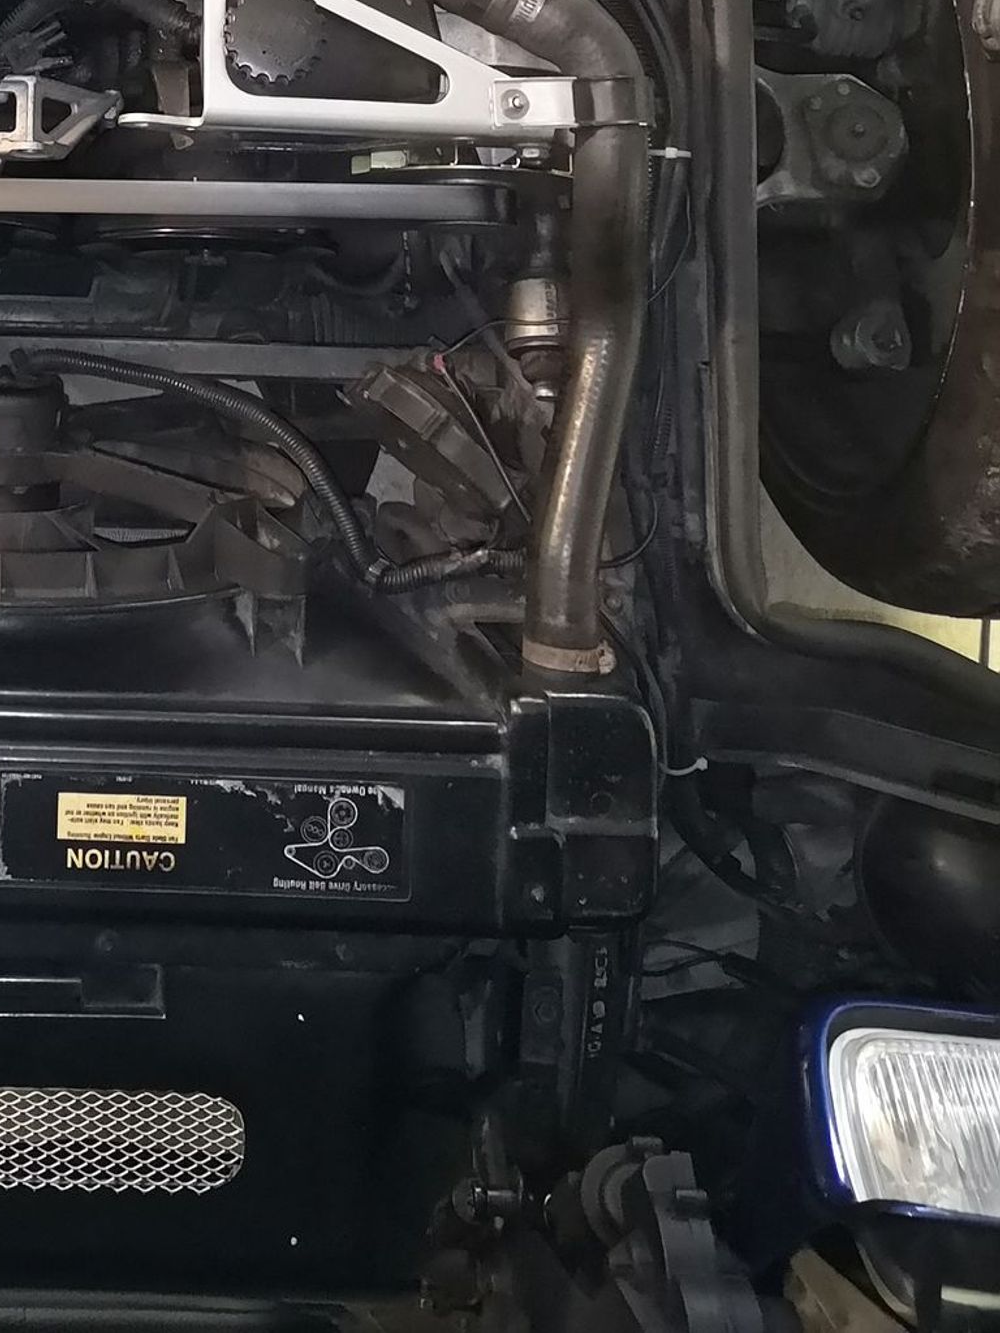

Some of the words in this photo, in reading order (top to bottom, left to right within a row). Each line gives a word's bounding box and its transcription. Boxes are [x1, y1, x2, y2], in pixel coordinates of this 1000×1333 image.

[294, 784, 326, 795] Manual
[67, 848, 176, 872] CAUTION
[273, 877, 306, 890] Routing
